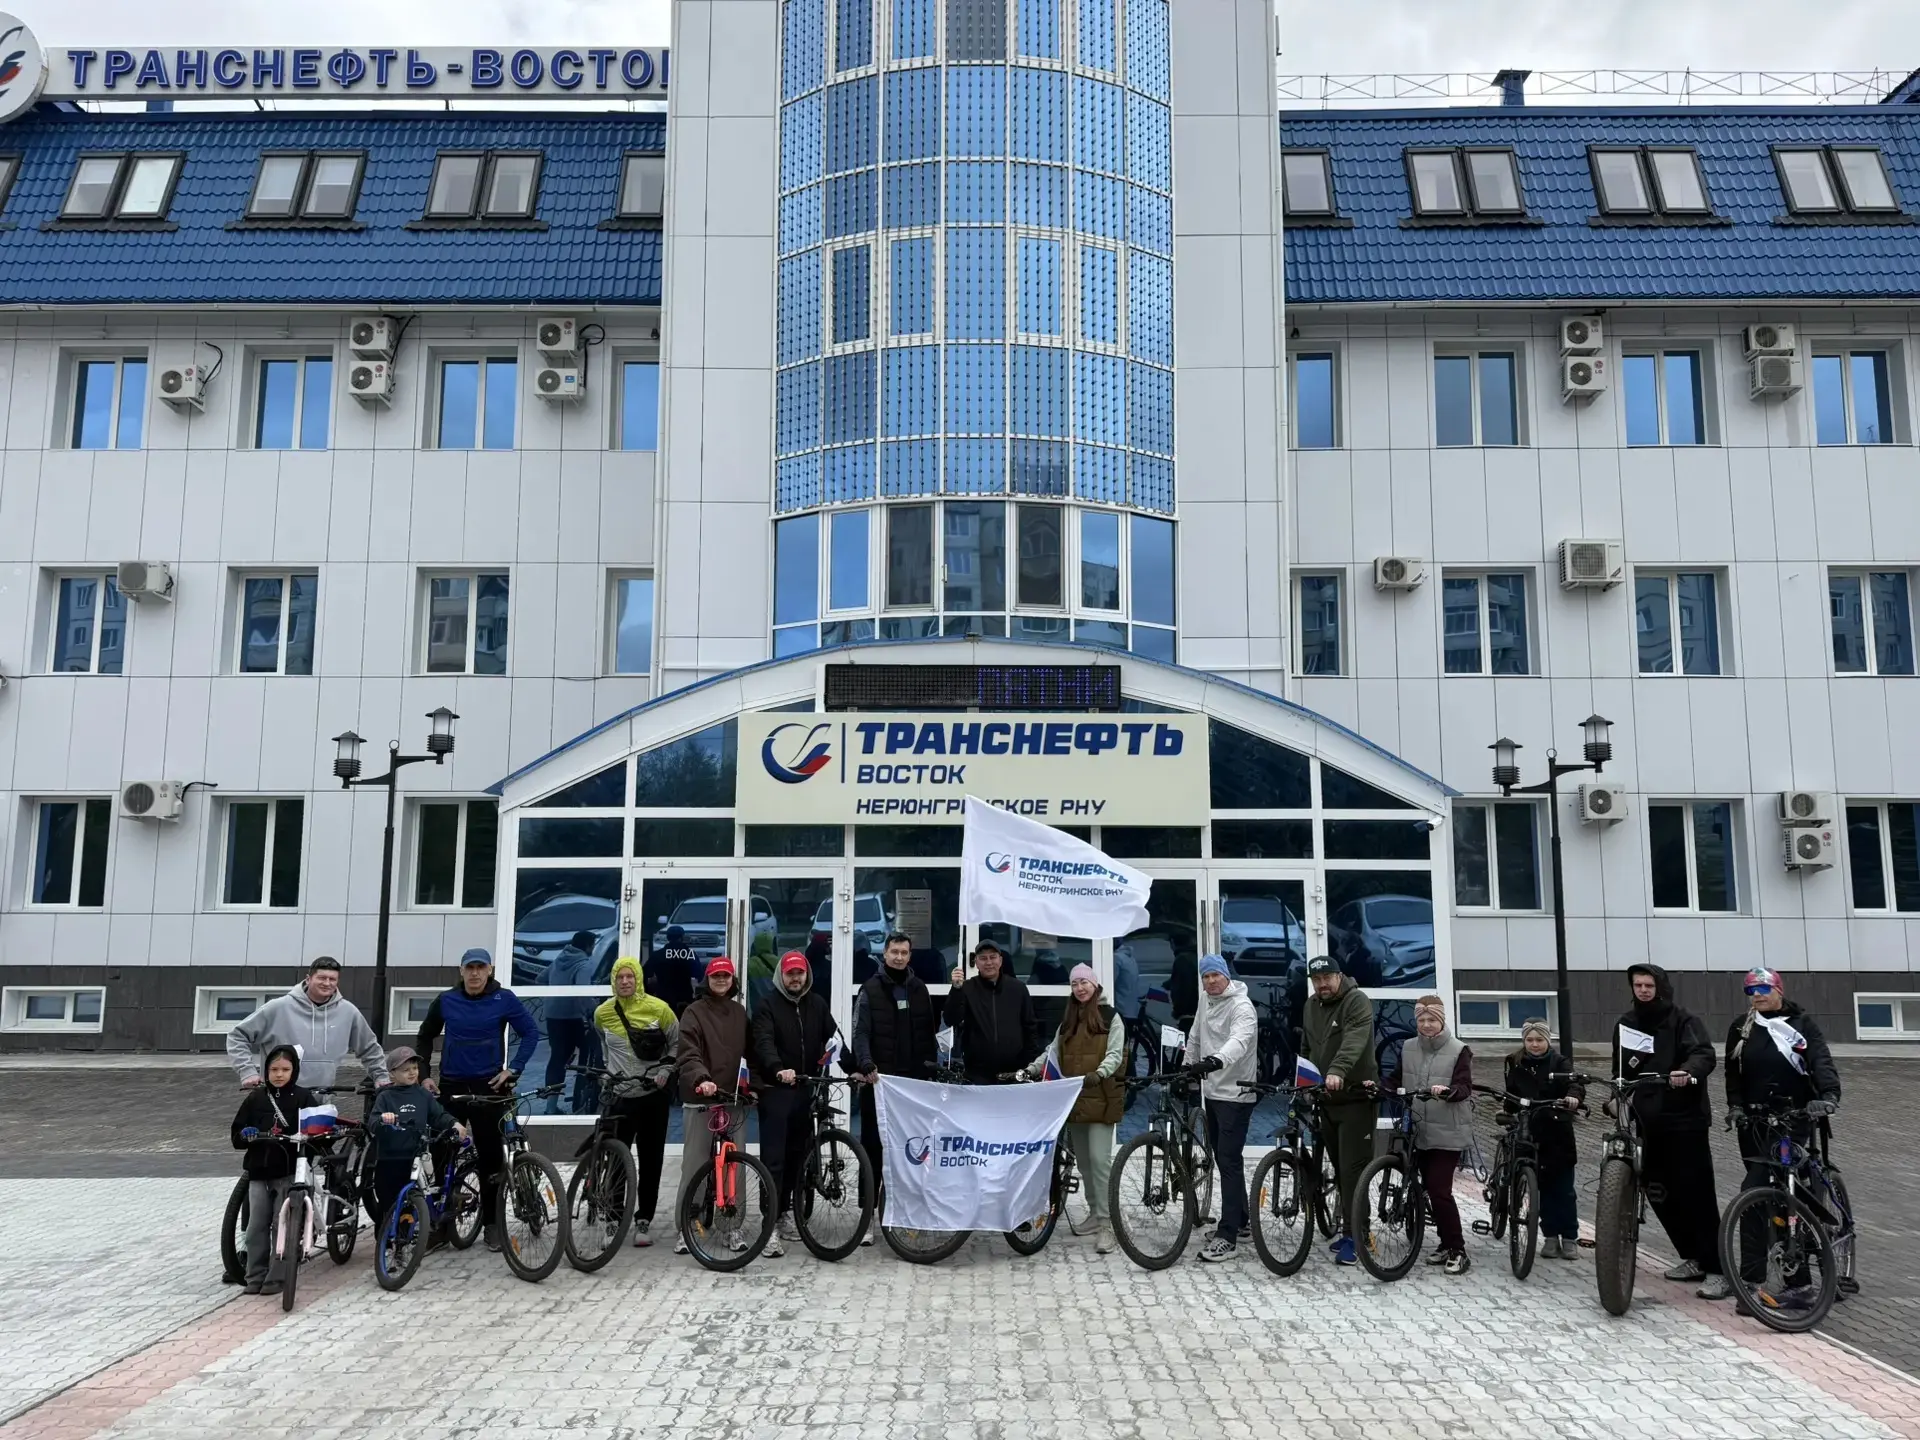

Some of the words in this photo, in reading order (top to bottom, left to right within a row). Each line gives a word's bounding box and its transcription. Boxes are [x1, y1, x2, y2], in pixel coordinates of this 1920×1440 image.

[855, 722, 1185, 756] ТРАНСНЕФТЬ
[856, 764, 967, 785] ВОСТОК
[856, 798, 1049, 815] НЕРЮНГРСКОЕ
[1060, 799, 1107, 816] РНУ
[1018, 857, 1129, 885] ТРАНСНЕФТЬ
[1018, 871, 1064, 885] ВОСТОК
[1018, 881, 1104, 897] НЕРЮНГРИНСКОЕ
[1104, 888, 1124, 897] РНУ
[665, 948, 696, 961] ВХОД
[939, 1155, 988, 1168] ВОСТОК
